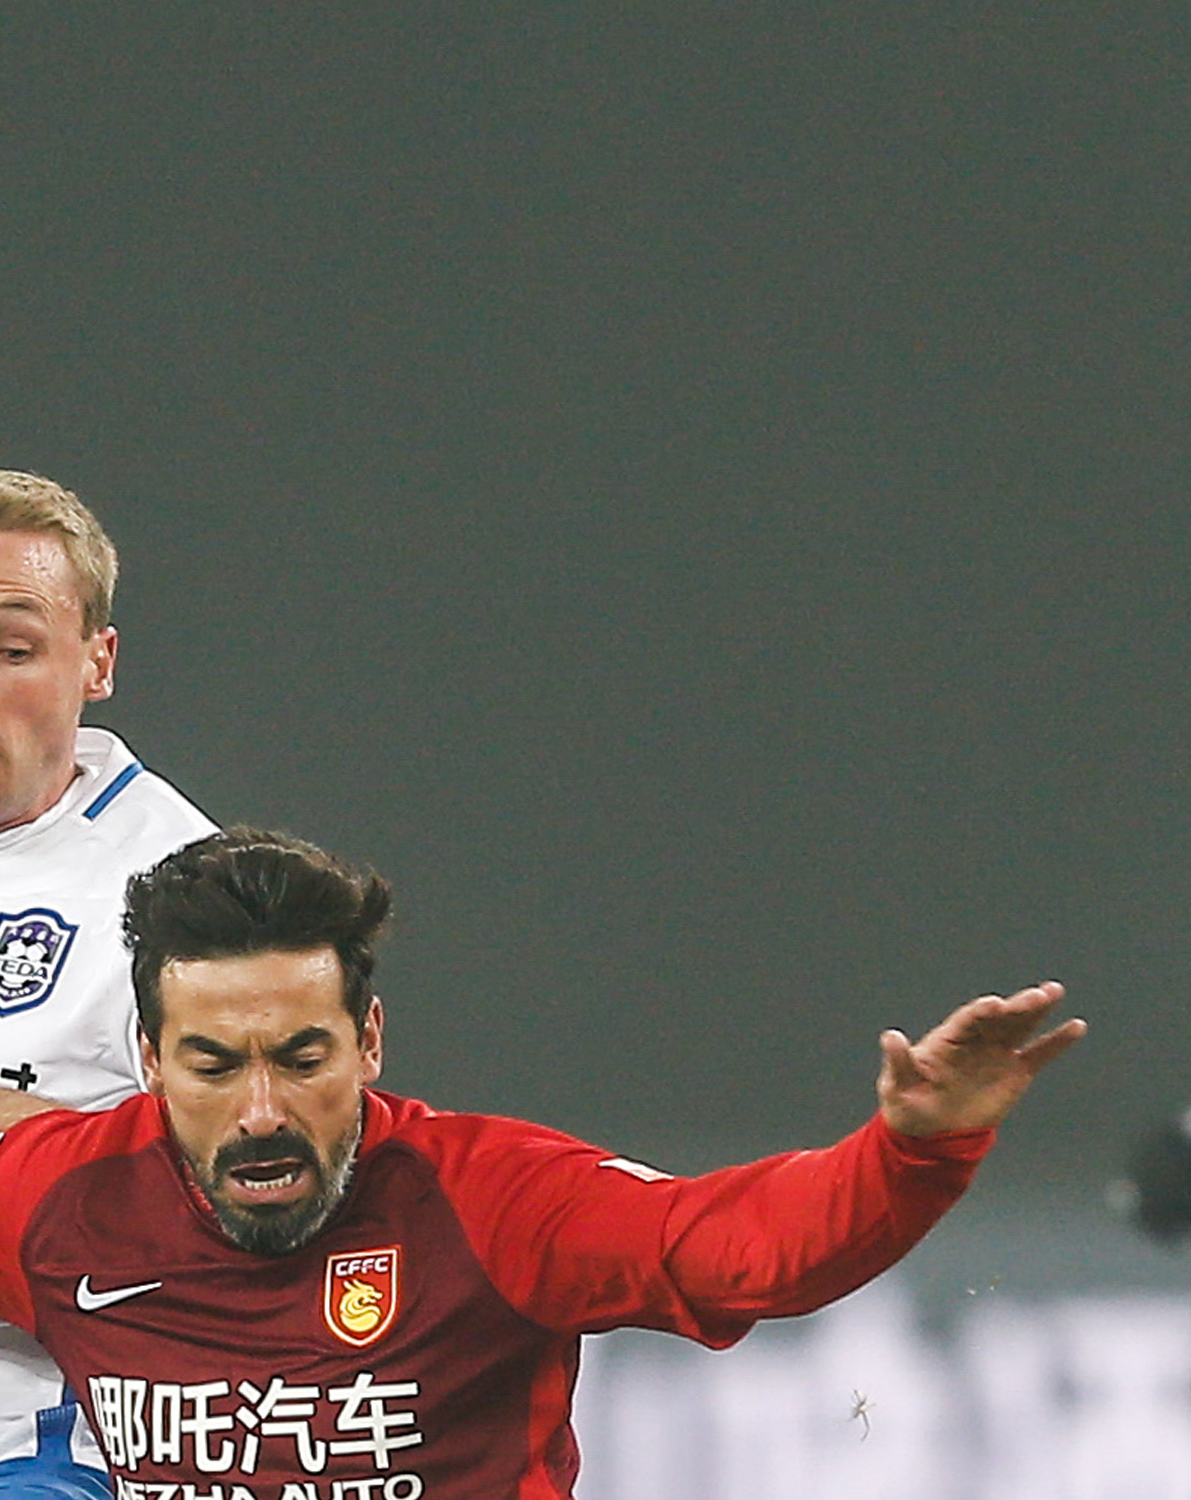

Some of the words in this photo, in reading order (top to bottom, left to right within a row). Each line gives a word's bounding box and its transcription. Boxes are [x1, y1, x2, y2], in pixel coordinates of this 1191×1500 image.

[335, 1256, 389, 1277] CFFC
[88, 1372, 423, 1474] 哪吒汽车
